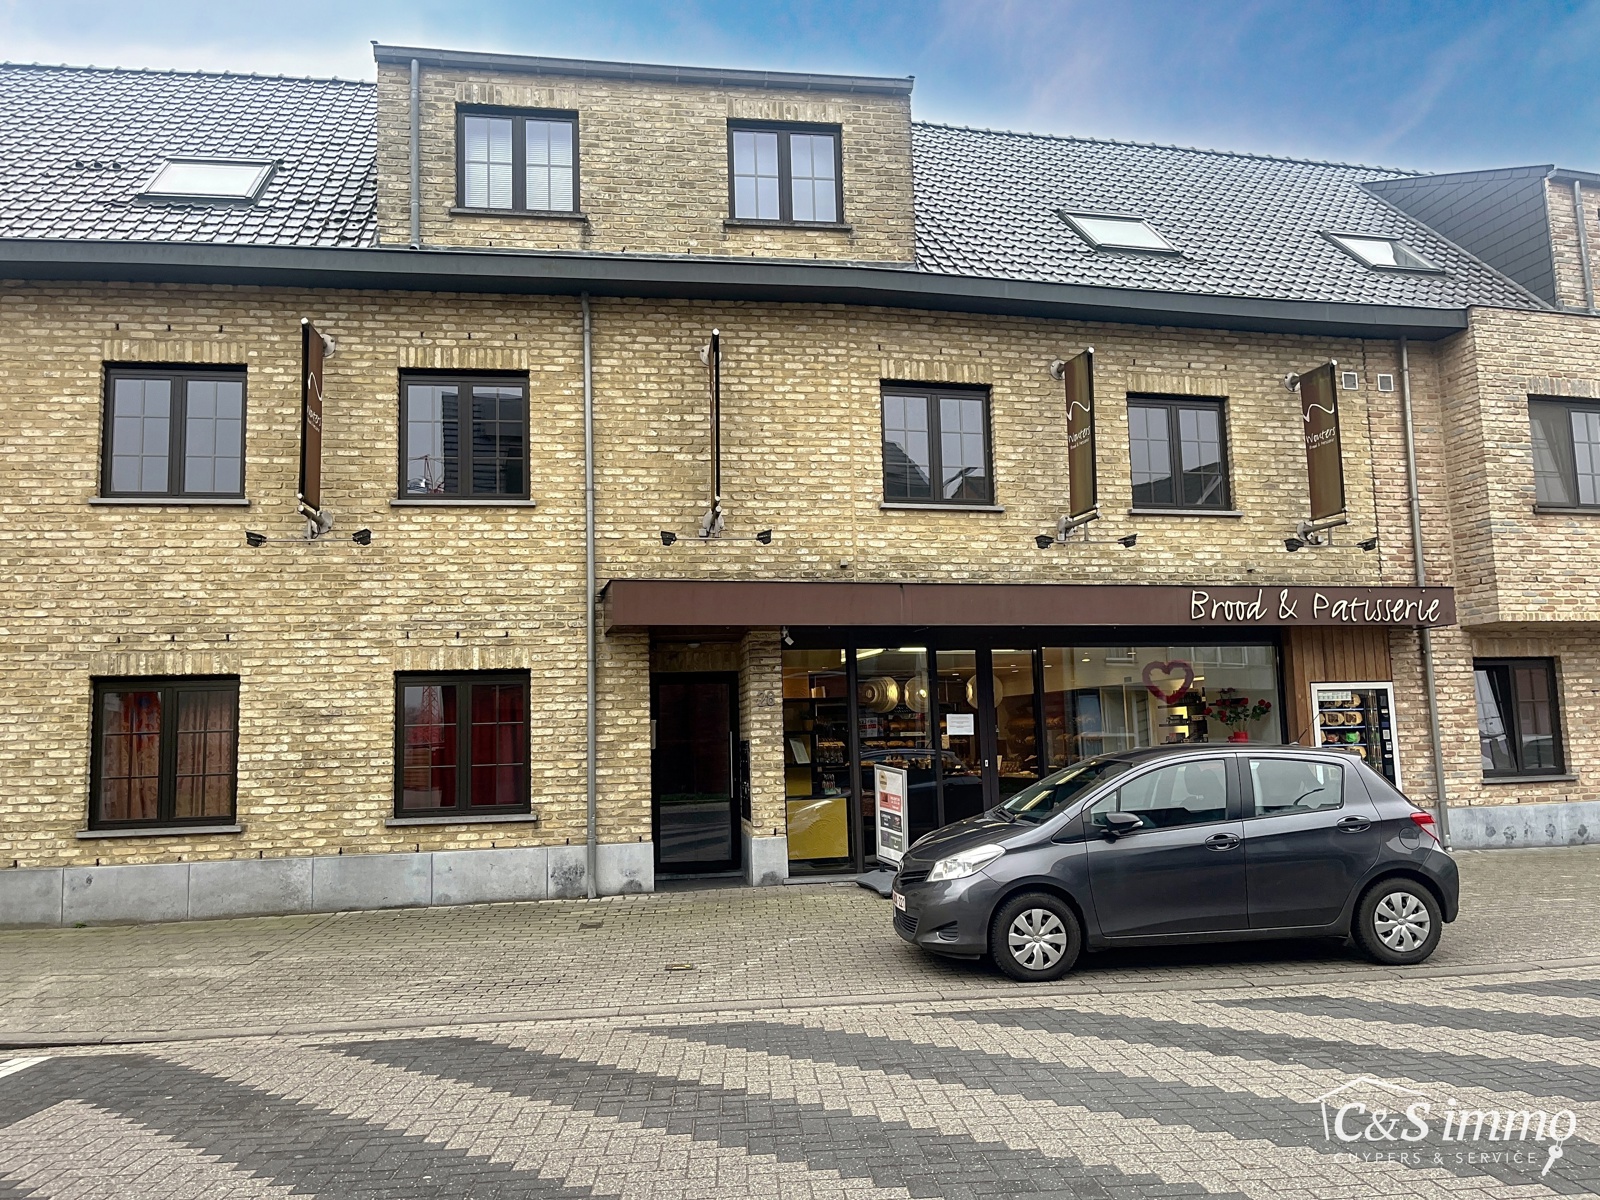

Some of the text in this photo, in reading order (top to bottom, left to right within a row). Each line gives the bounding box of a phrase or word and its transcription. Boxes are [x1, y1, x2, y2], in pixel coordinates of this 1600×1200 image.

[1191, 588, 1441, 622] Brood & Patisserie
